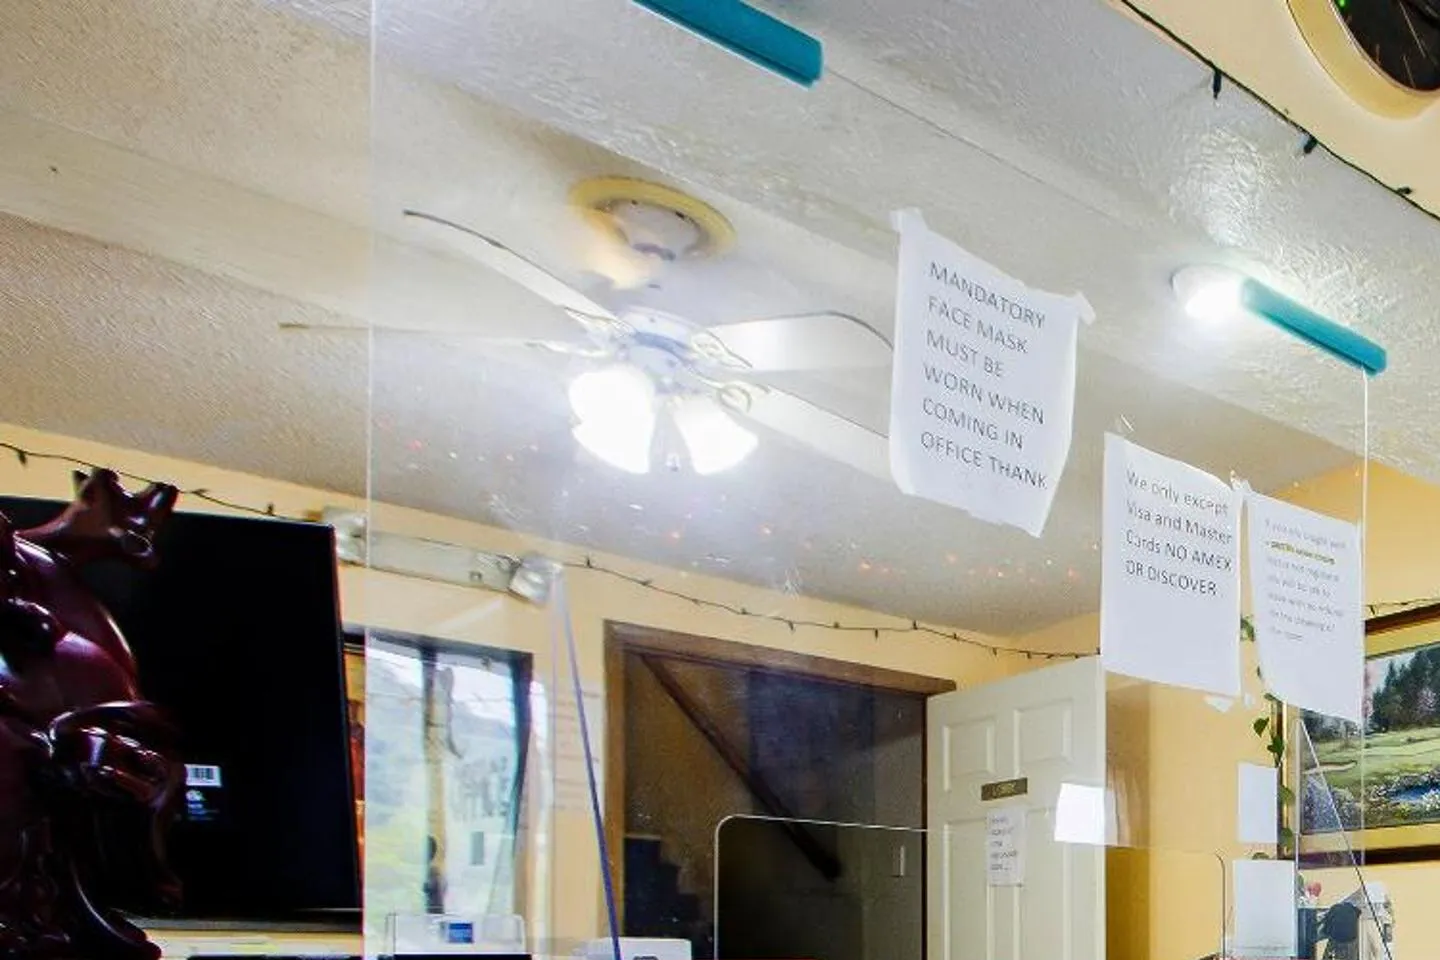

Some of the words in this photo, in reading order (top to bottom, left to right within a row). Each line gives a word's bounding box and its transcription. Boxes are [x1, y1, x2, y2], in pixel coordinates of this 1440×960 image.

[929, 261, 1046, 330] MANDATORY
[928, 296, 972, 330] FACE
[976, 320, 1029, 354] MASK
[926, 329, 979, 366] MUST
[984, 356, 1004, 377] BE
[922, 363, 983, 402] WORN
[988, 391, 1045, 426] WHEN
[922, 398, 999, 441] COMING
[1005, 430, 1024, 450] IN
[920, 432, 983, 468] OFFICE
[988, 455, 1049, 491] THANK
[1126, 469, 1148, 490] We
[1151, 482, 1180, 504] only
[1184, 493, 1229, 517] except
[1126, 499, 1152, 521] Visa
[1155, 514, 1182, 531] and
[1185, 519, 1233, 545] Master
[1126, 530, 1161, 554] Cards
[1165, 542, 1188, 562] NO
[1191, 550, 1232, 572] AMEX
[1126, 560, 1144, 577] OR
[1147, 565, 1217, 596] DISCOVER
